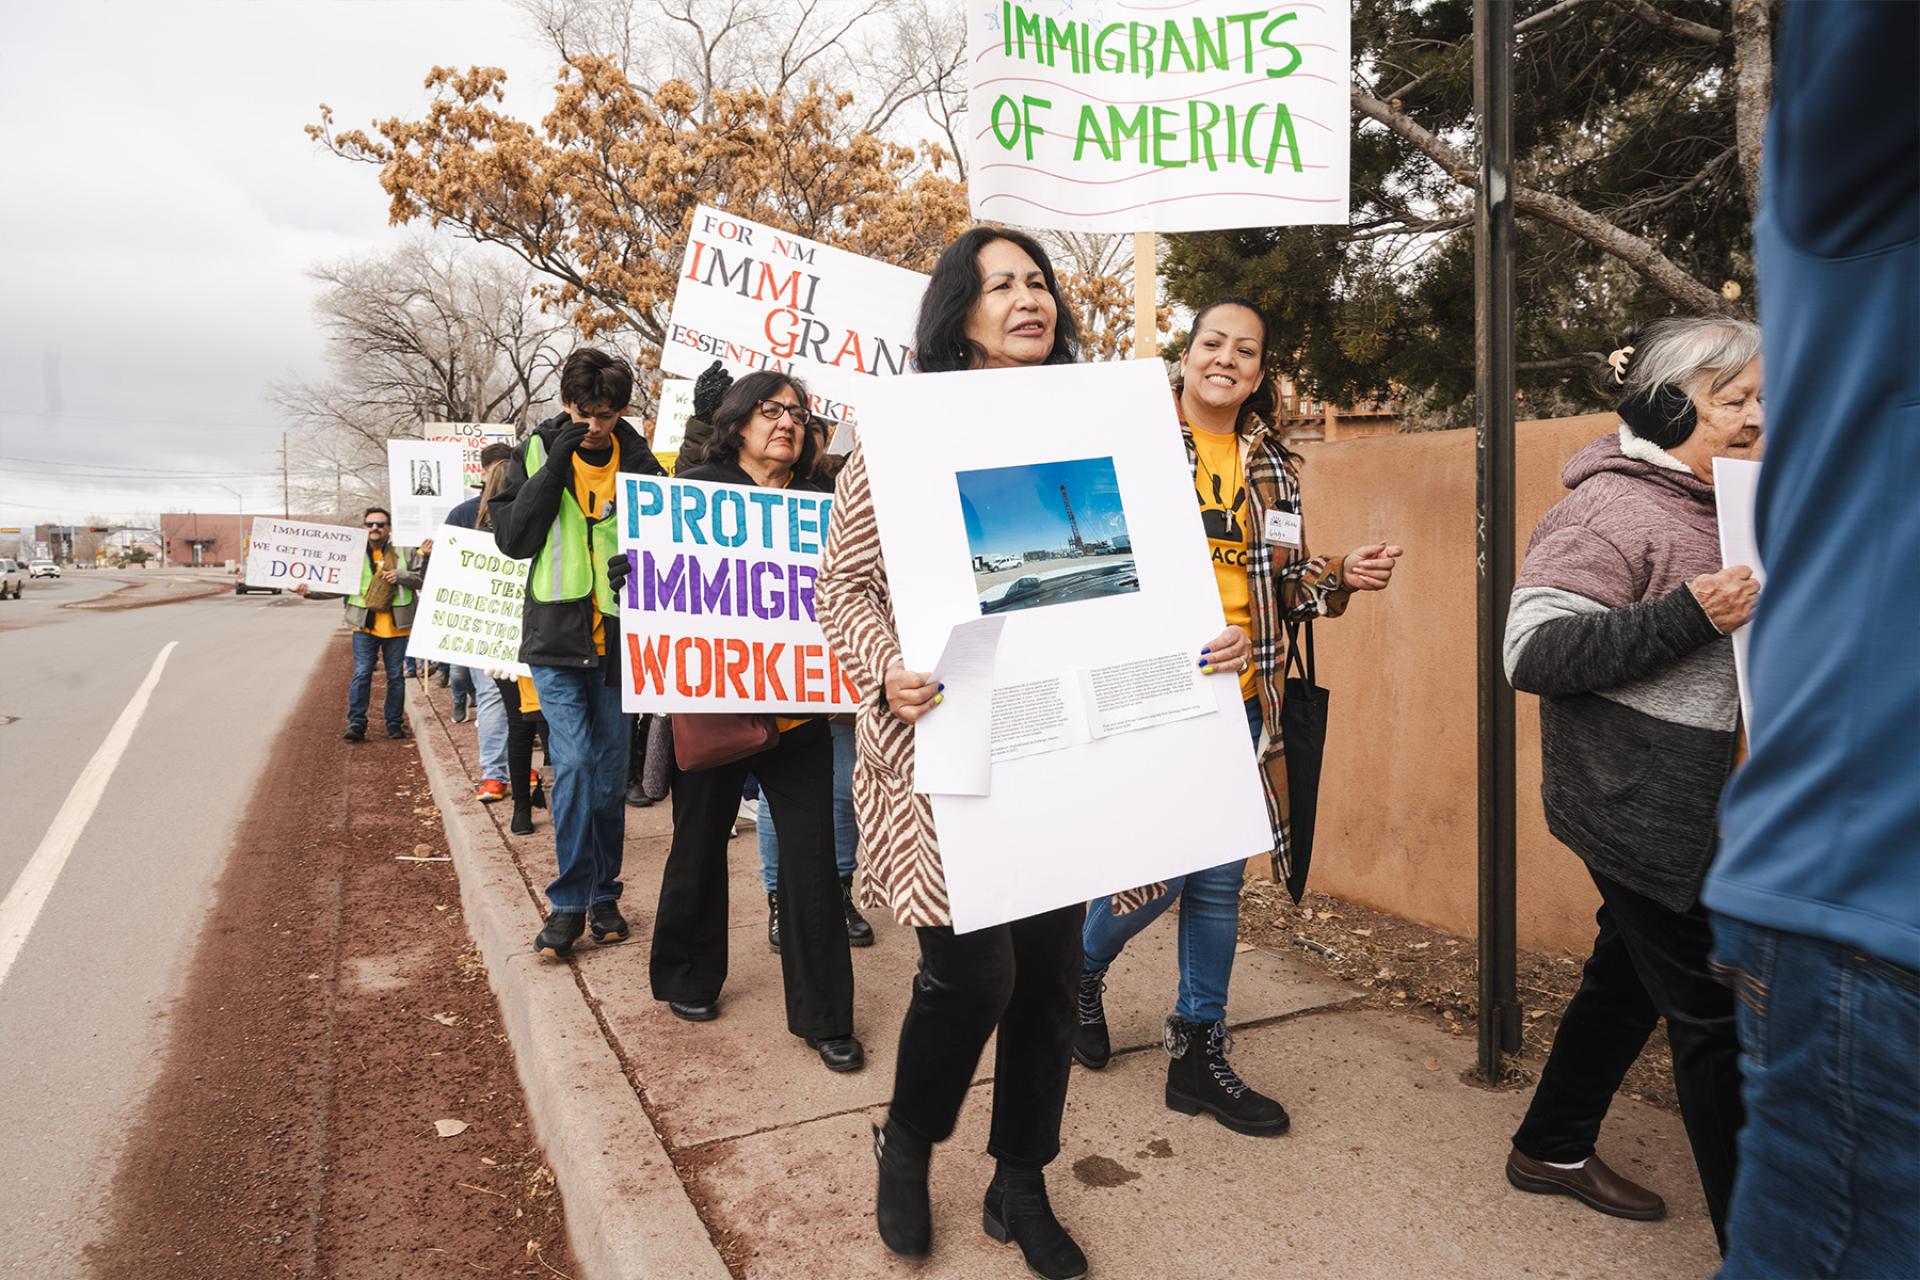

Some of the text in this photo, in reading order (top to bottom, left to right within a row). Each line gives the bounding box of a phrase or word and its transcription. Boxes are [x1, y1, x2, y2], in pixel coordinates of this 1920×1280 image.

[1003, 1, 1303, 79] IMMIGRANTS
[991, 94, 1304, 174] OF AMERICA
[702, 214, 817, 265] FOR NM
[684, 240, 821, 316] IMMI
[764, 307, 918, 376] GRAN
[454, 424, 483, 438] LOS
[252, 541, 348, 563] WE GET THE JOB
[272, 524, 353, 543] IMMIGRANTS
[270, 560, 341, 585] DONE
[461, 550, 528, 577] TODOS
[626, 549, 819, 623] IMMIGR
[438, 634, 519, 662] ACADÉM
